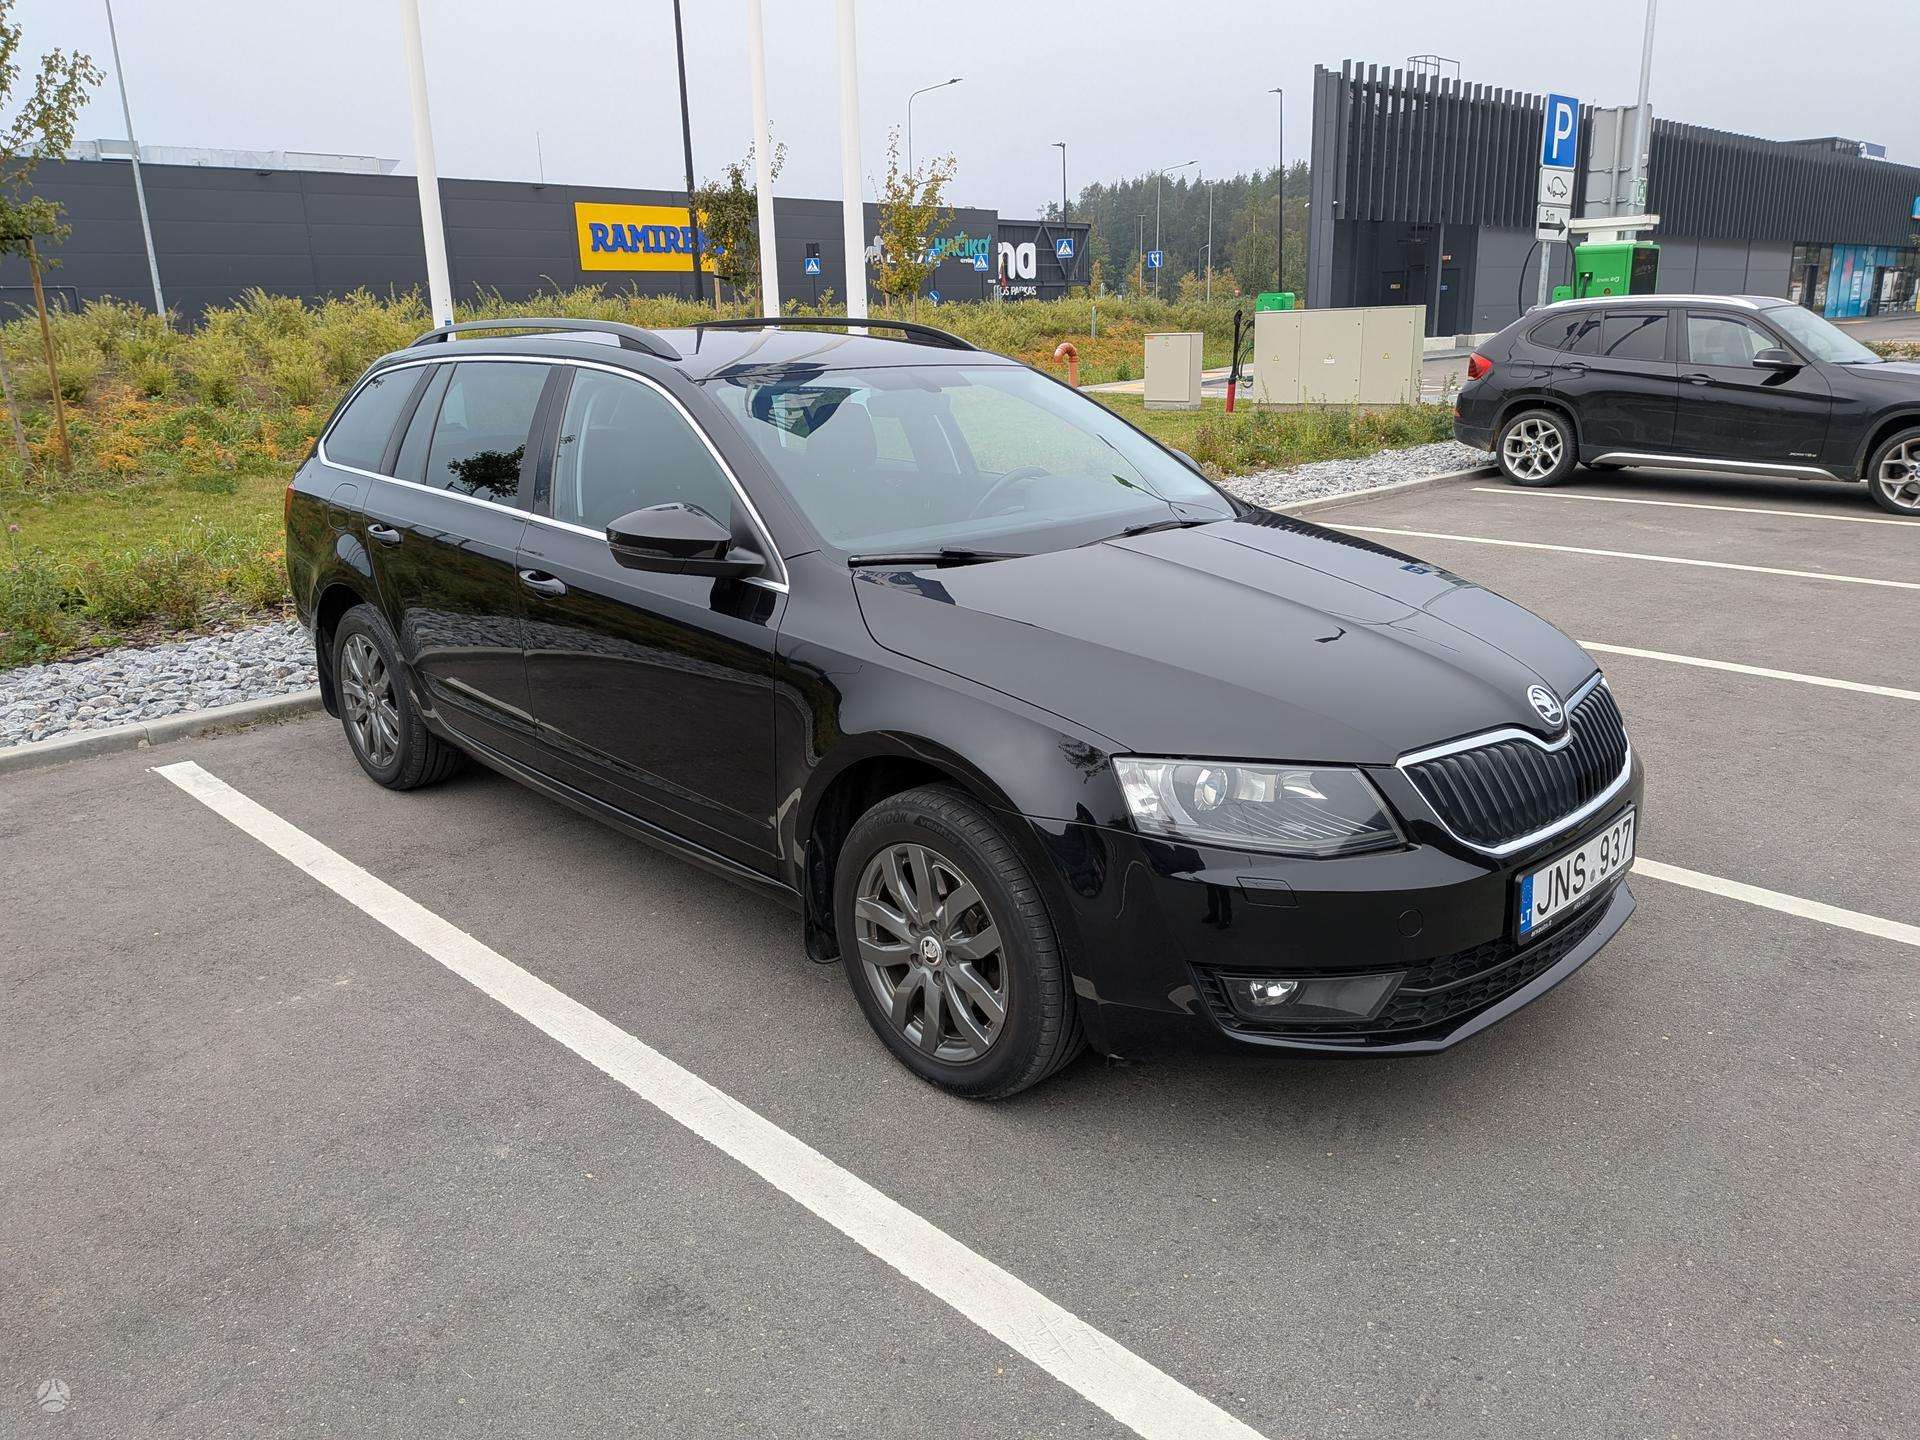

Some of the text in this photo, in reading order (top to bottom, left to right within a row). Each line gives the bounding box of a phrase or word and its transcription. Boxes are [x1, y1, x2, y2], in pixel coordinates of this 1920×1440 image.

[1552, 102, 1573, 159] P
[588, 222, 726, 255] RAMIRE
[1536, 819, 1632, 916] JNS 937
[1520, 909, 1532, 925] LT
